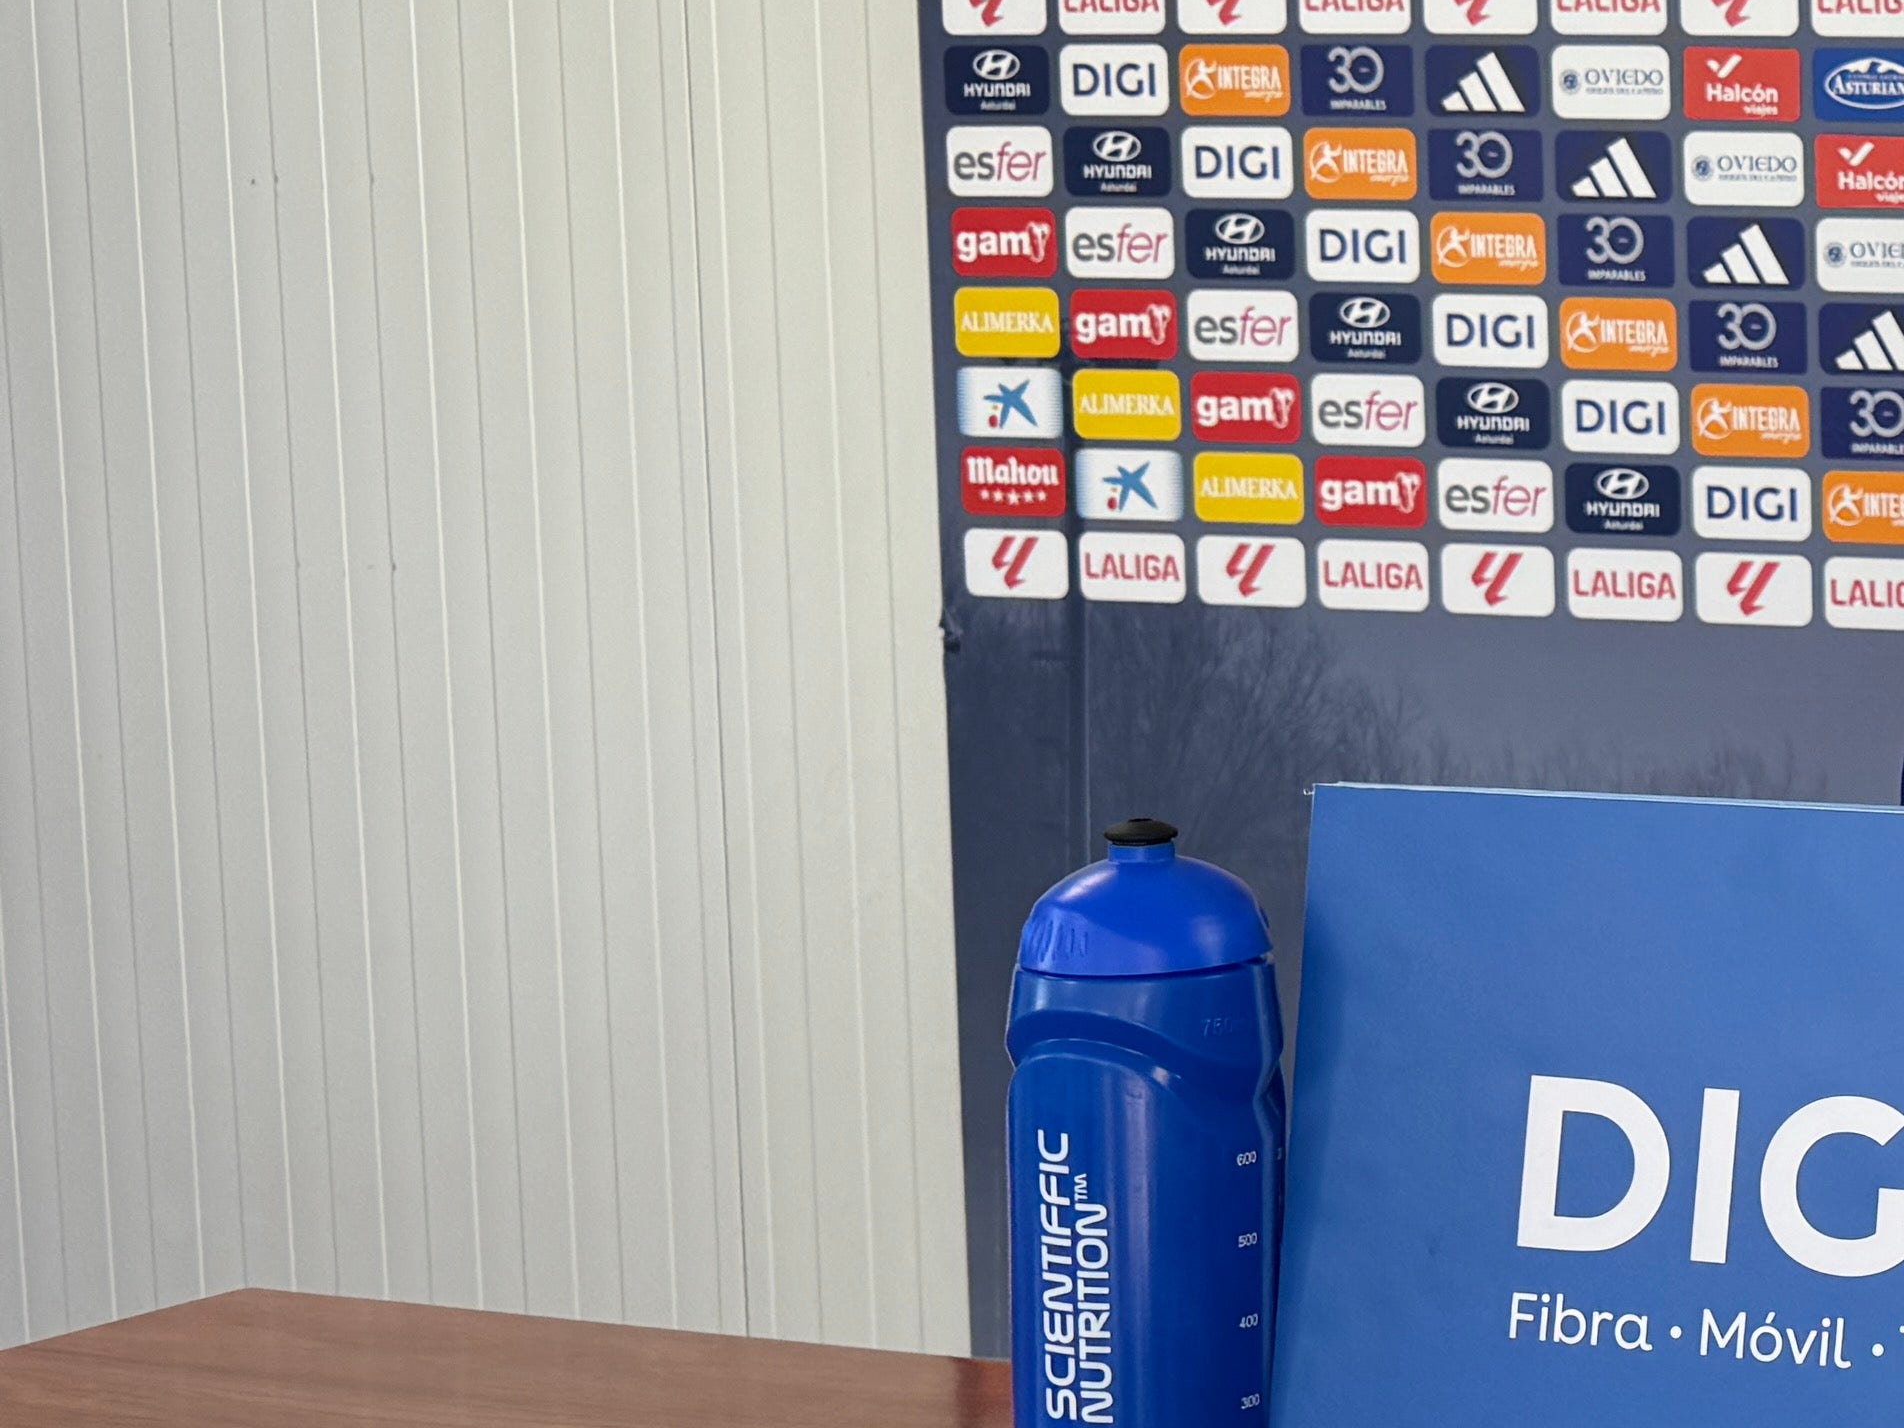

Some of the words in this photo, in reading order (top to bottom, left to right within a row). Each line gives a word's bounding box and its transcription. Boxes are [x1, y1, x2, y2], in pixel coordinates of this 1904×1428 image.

[1072, 63, 1155, 96] DIGI
[1205, 247, 1276, 261] HYUNDAI
[965, 456, 1059, 486] Mahou
[1200, 475, 1297, 500] ALIMERKA
[1586, 502, 1660, 517] HYUNDAI
[1236, 1150, 1257, 1167] 600
[1237, 1232, 1258, 1248] 500
[1036, 1128, 1078, 1422] SCIENTIFFIC
[1238, 1314, 1259, 1329] 400
[1508, 1292, 1653, 1352] Fibra
[1699, 1308, 1852, 1370] Móvil
[1240, 1393, 1261, 1409] 300
